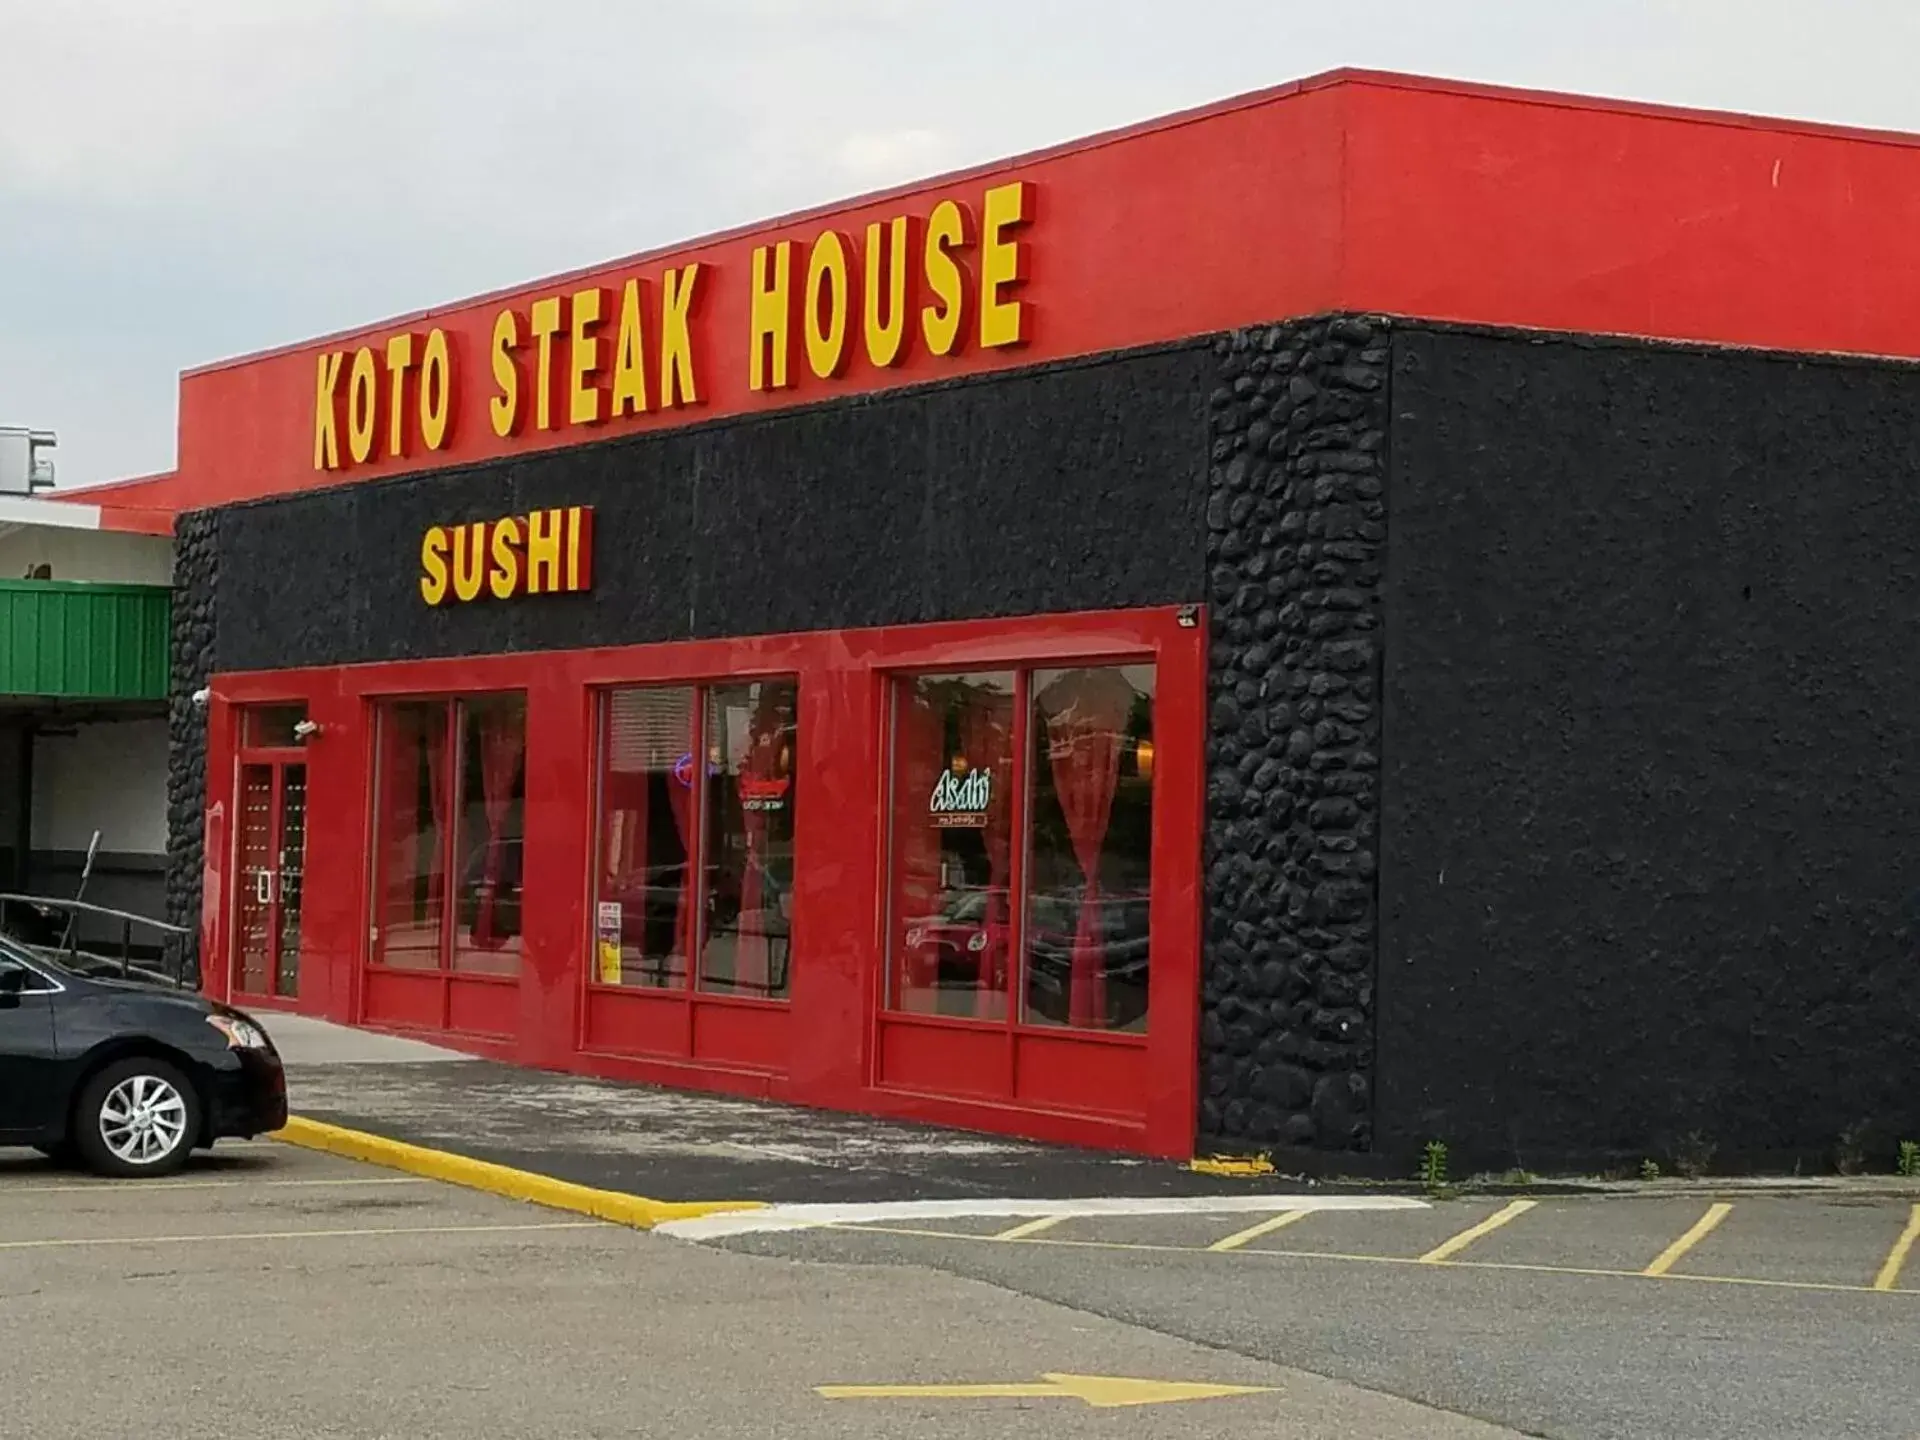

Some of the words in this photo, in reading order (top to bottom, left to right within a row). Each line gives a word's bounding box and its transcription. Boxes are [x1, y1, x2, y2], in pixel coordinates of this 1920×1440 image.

[313, 327, 452, 472] KOTO
[489, 262, 702, 439] STEAK
[748, 181, 1024, 393] HOUSE
[420, 506, 586, 606] SUSHI
[930, 766, 990, 811] Asahi
